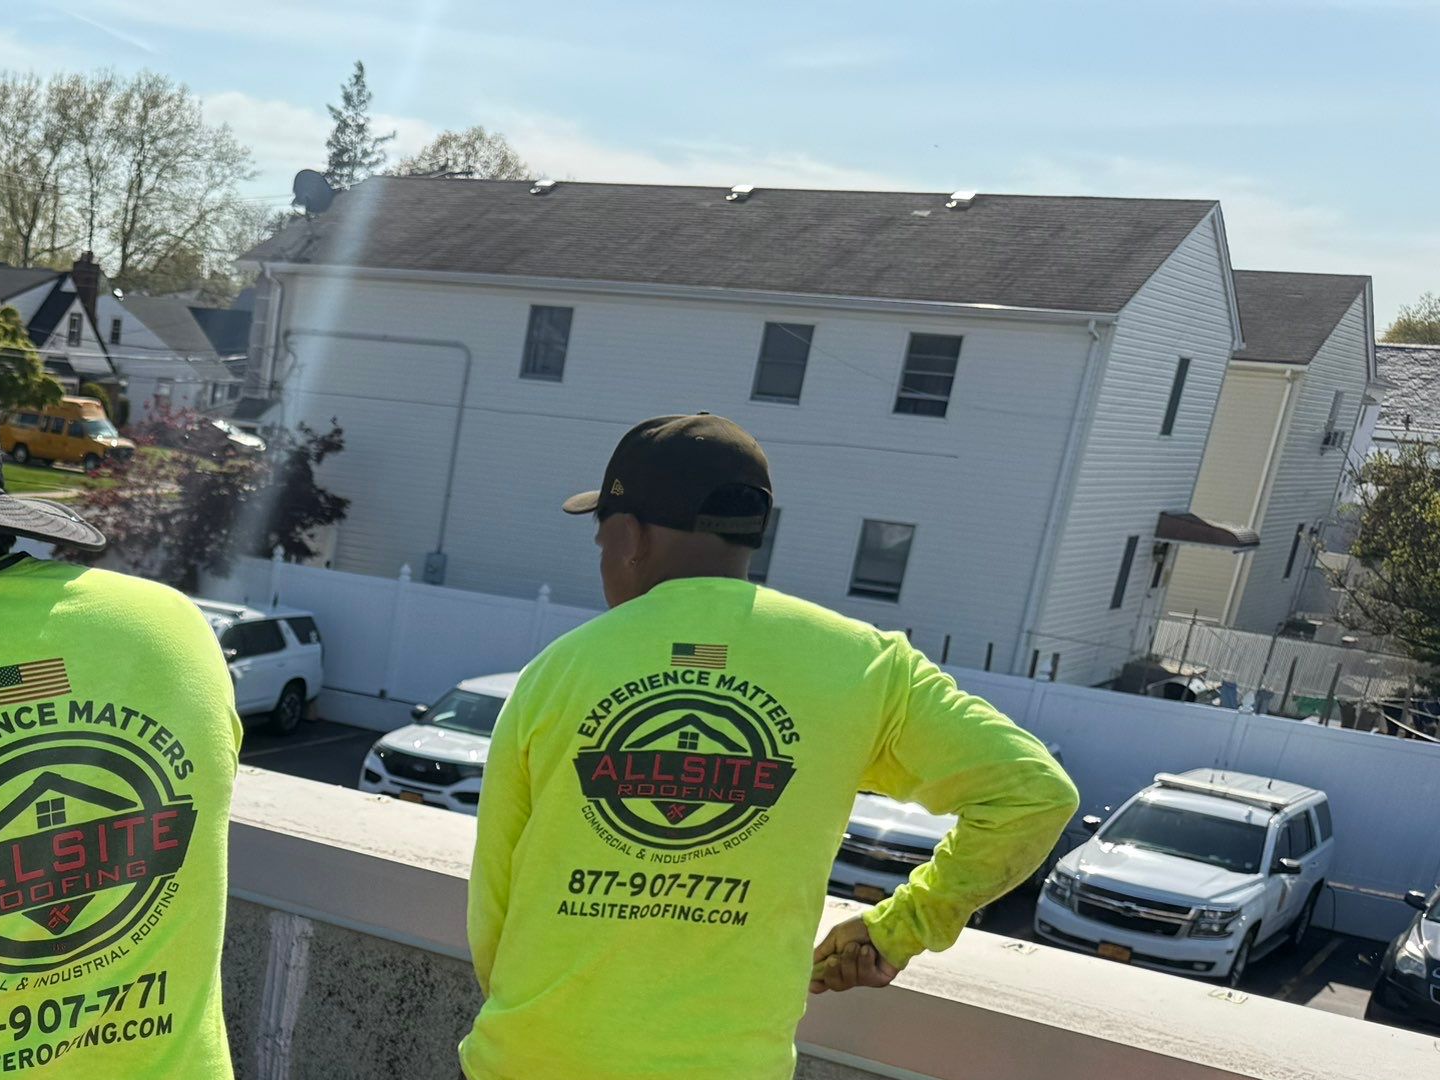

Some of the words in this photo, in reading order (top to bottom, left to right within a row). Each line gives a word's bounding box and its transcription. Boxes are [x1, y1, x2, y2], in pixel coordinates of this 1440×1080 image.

[578, 670, 711, 738] EXPERIENCE
[716, 675, 801, 745] MATTERS
[68, 701, 194, 781] MATTERS
[591, 753, 779, 790] ALLSITE
[617, 783, 746, 803] ROOFING
[581, 804, 631, 857] COMMERCIAL
[636, 849, 646, 860] &
[650, 848, 720, 864] INDUSTRIAL
[724, 813, 770, 850] ROOFING
[568, 869, 751, 903] 877-907-7771
[15, 977, 29, 991] &
[33, 946, 130, 989] INDUSTRIAL
[133, 881, 180, 945] ROOFING
[557, 900, 749, 926] ALLSITEROOFING.COM
